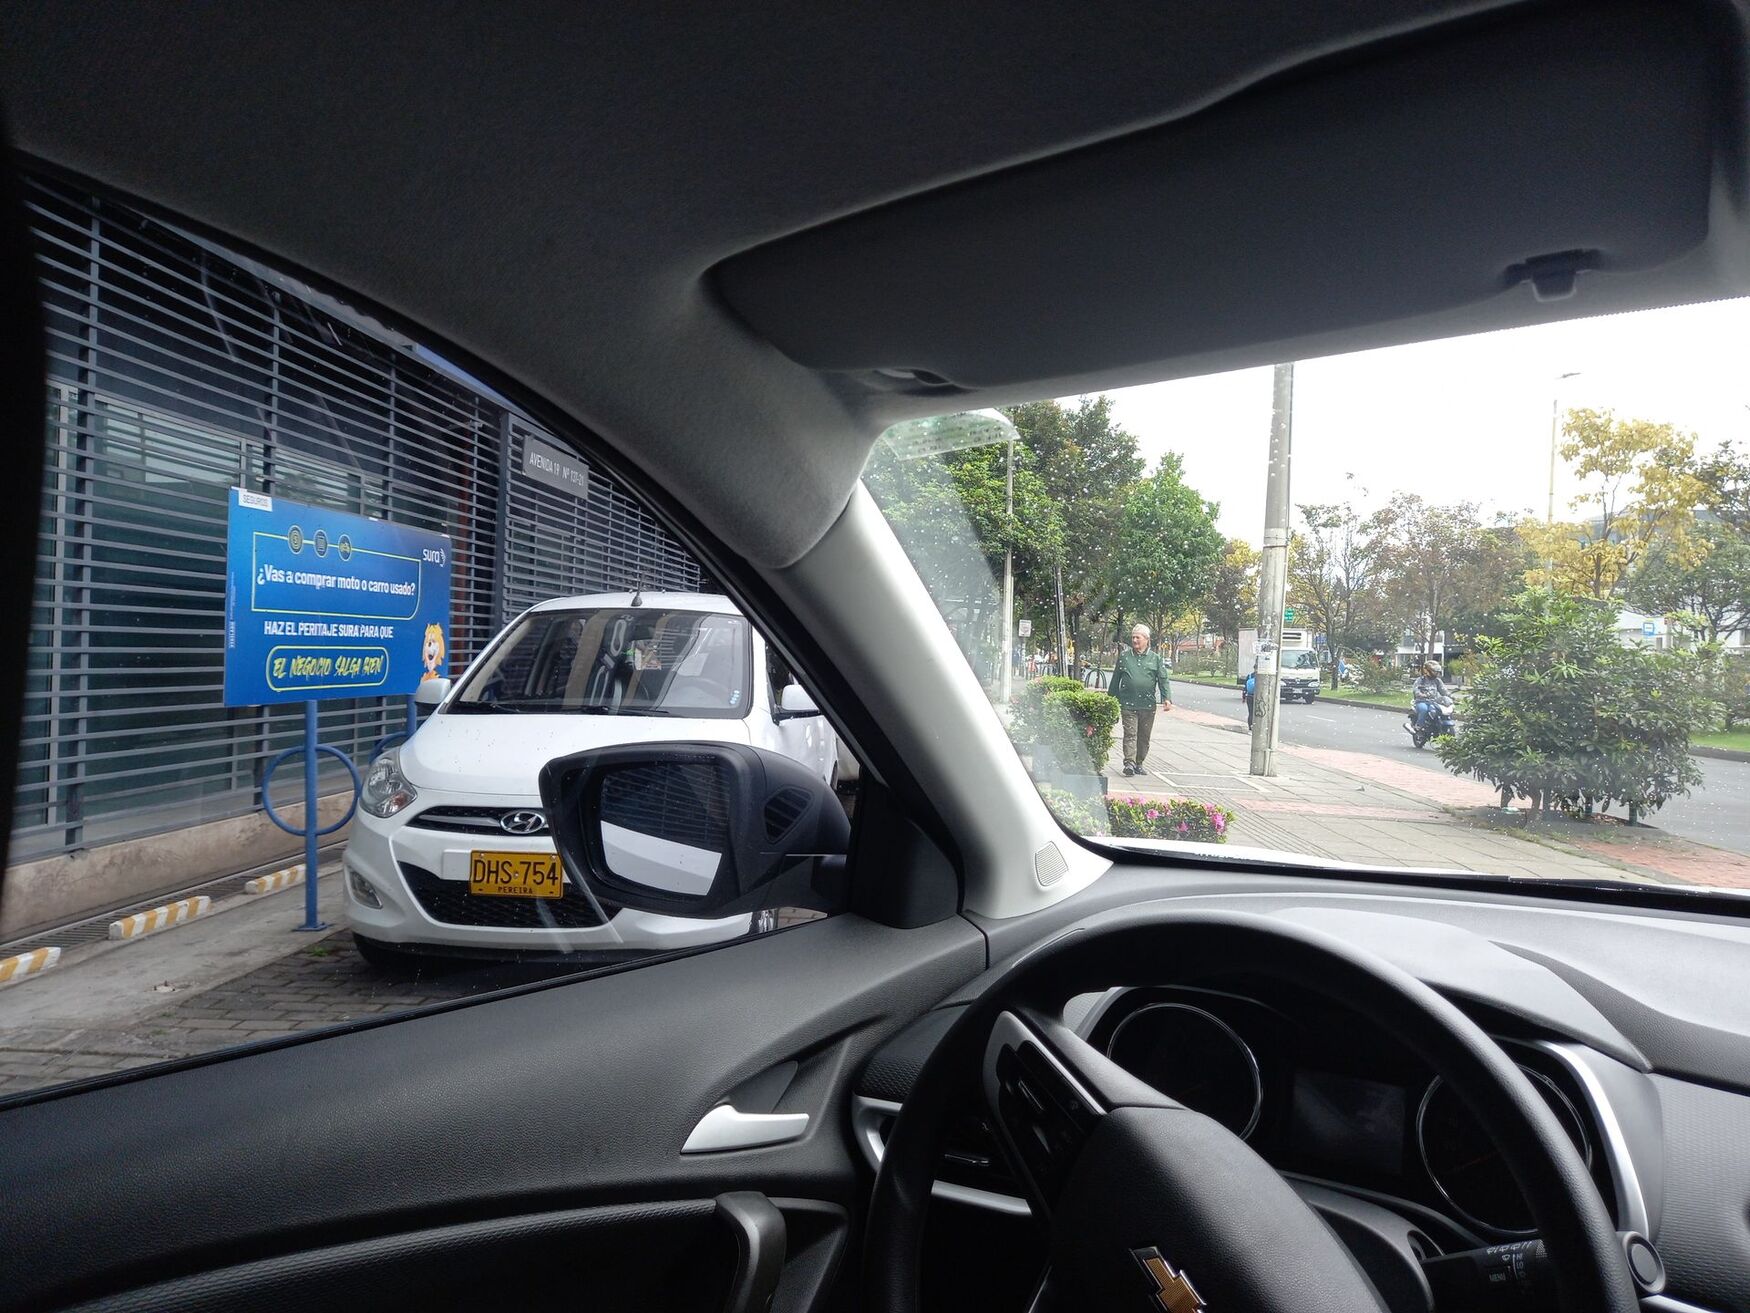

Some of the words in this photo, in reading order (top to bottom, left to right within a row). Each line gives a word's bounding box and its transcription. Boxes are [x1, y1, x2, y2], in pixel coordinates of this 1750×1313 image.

[529, 451, 553, 473] AVENIDA
[423, 548, 440, 564] sura
[257, 564, 284, 585] ¿Vas
[286, 572, 293, 583] a
[294, 571, 336, 589] comprar
[337, 576, 361, 591] moto
[361, 580, 368, 591] o
[368, 581, 390, 594] carro
[390, 581, 416, 596] usado?
[264, 621, 285, 635] HAZ
[285, 622, 298, 636] EL
[298, 622, 337, 637] PERITAJE
[338, 624, 359, 638] SURA
[359, 624, 379, 638] PARA
[380, 626, 394, 640] QUE
[273, 657, 287, 679] EL
[289, 655, 332, 680] NEGOCIO
[334, 655, 360, 678] SALGA
[473, 860, 512, 884] DHS
[520, 861, 558, 886] 754
[498, 886, 533, 894] PEREIRA
